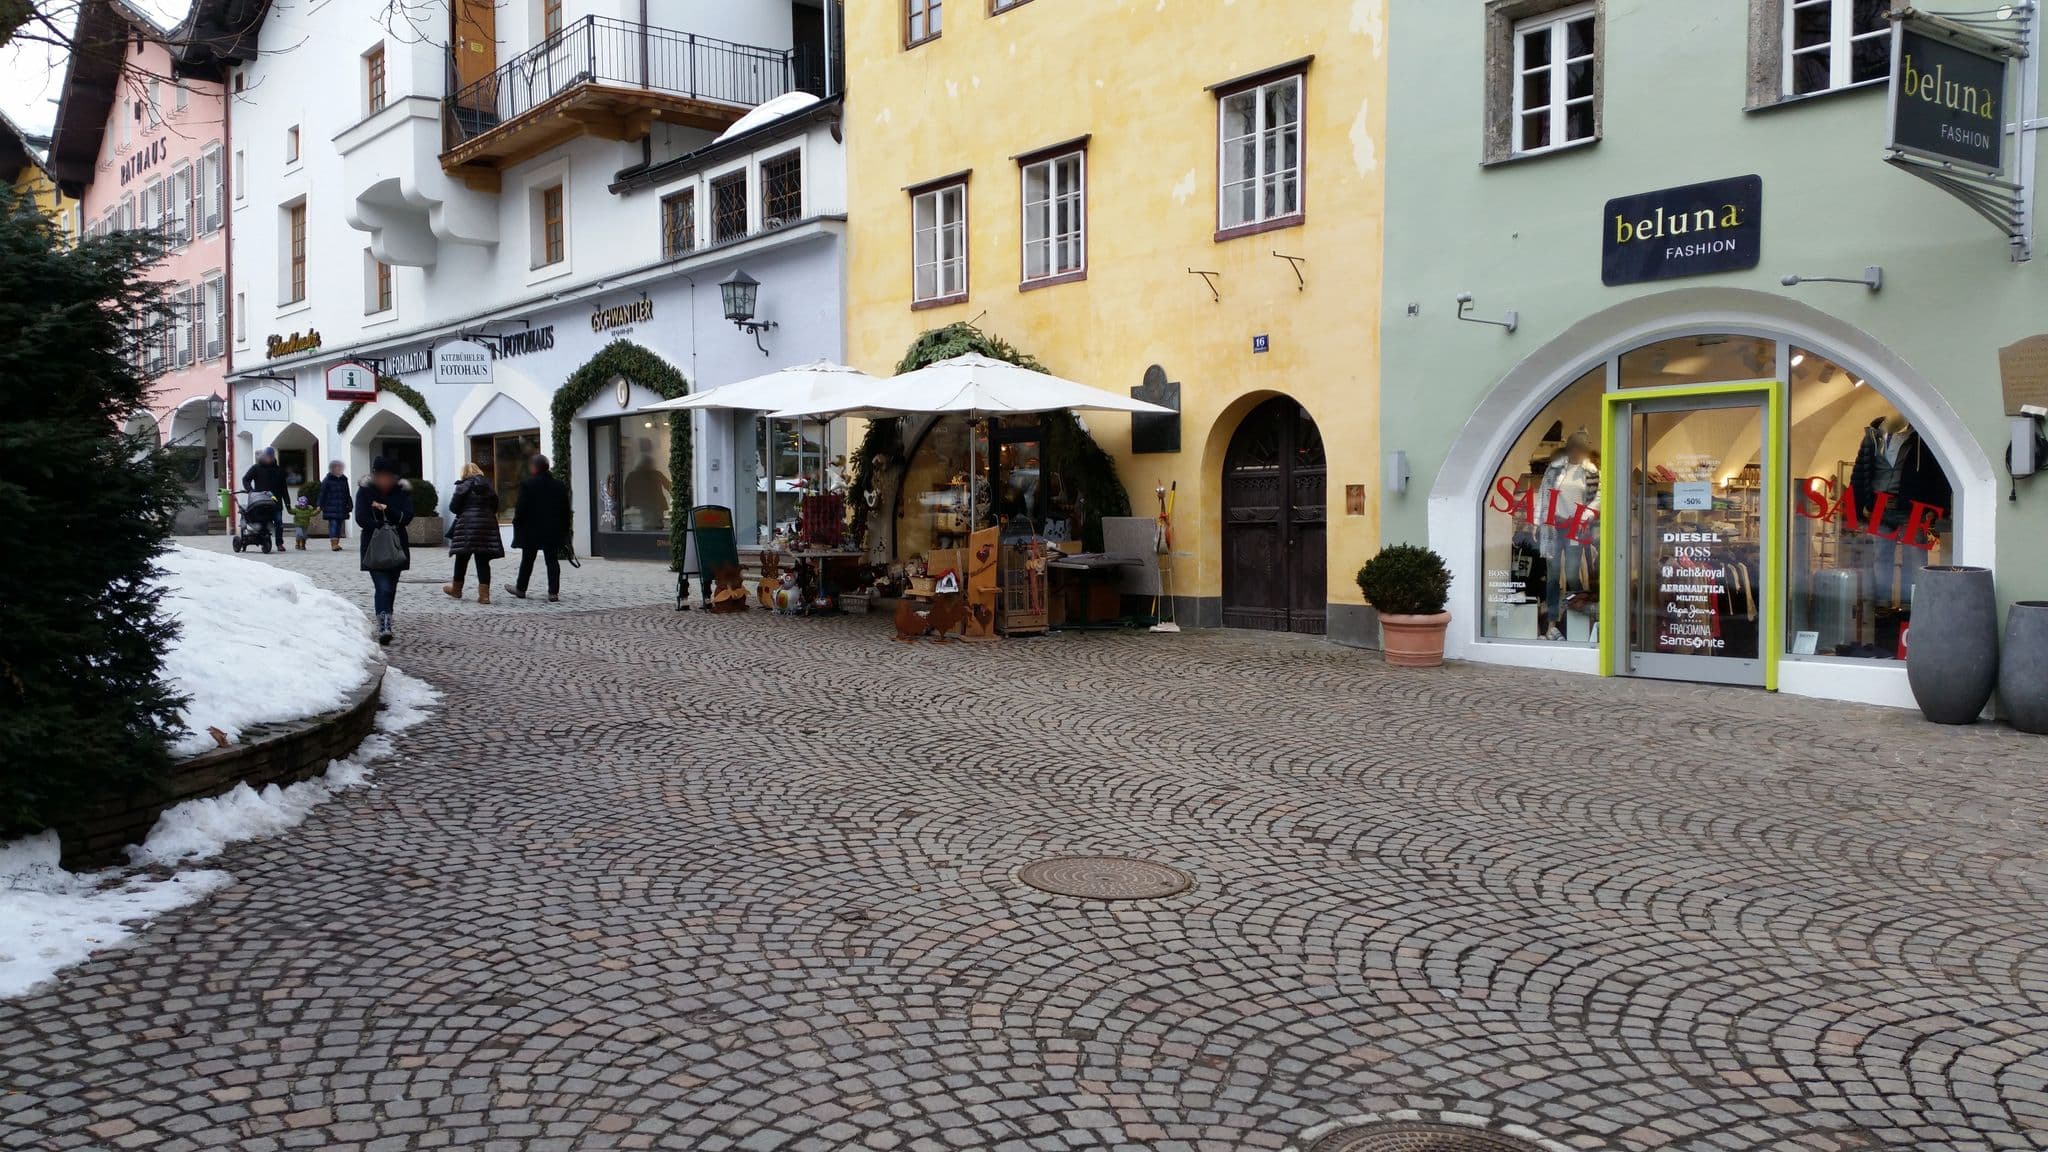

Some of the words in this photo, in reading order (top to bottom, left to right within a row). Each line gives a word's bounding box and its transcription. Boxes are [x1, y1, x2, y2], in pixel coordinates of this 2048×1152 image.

[1905, 54, 1992, 119] beluna
[1941, 124, 1989, 149] FASHION
[121, 136, 167, 187] RATHAUS
[1615, 204, 1744, 244] beluna
[1666, 239, 1736, 260] FASHION
[591, 300, 653, 332] GSCHWANTLER
[503, 325, 554, 358] FOTOHAUS
[1256, 336, 1265, 347] 16
[441, 352, 485, 361] KITZBÜHELER
[385, 351, 429, 377] INFORMATION
[440, 364, 488, 376] FOTOHAUS
[251, 399, 282, 413] KINO
[1490, 476, 1600, 545] SALE
[1796, 476, 1945, 551] SALE
[1663, 533, 1722, 542] DIESEL
[1675, 546, 1711, 557] BOSS
[1488, 569, 1510, 577] BOSS
[1676, 567, 1725, 580] rich&royal
[1660, 584, 1725, 594] AERONAUTICA
[1676, 594, 1708, 602] MILITARE
[1669, 623, 1711, 636] FRACOMINA
[1660, 635, 1726, 648] Samsonite
